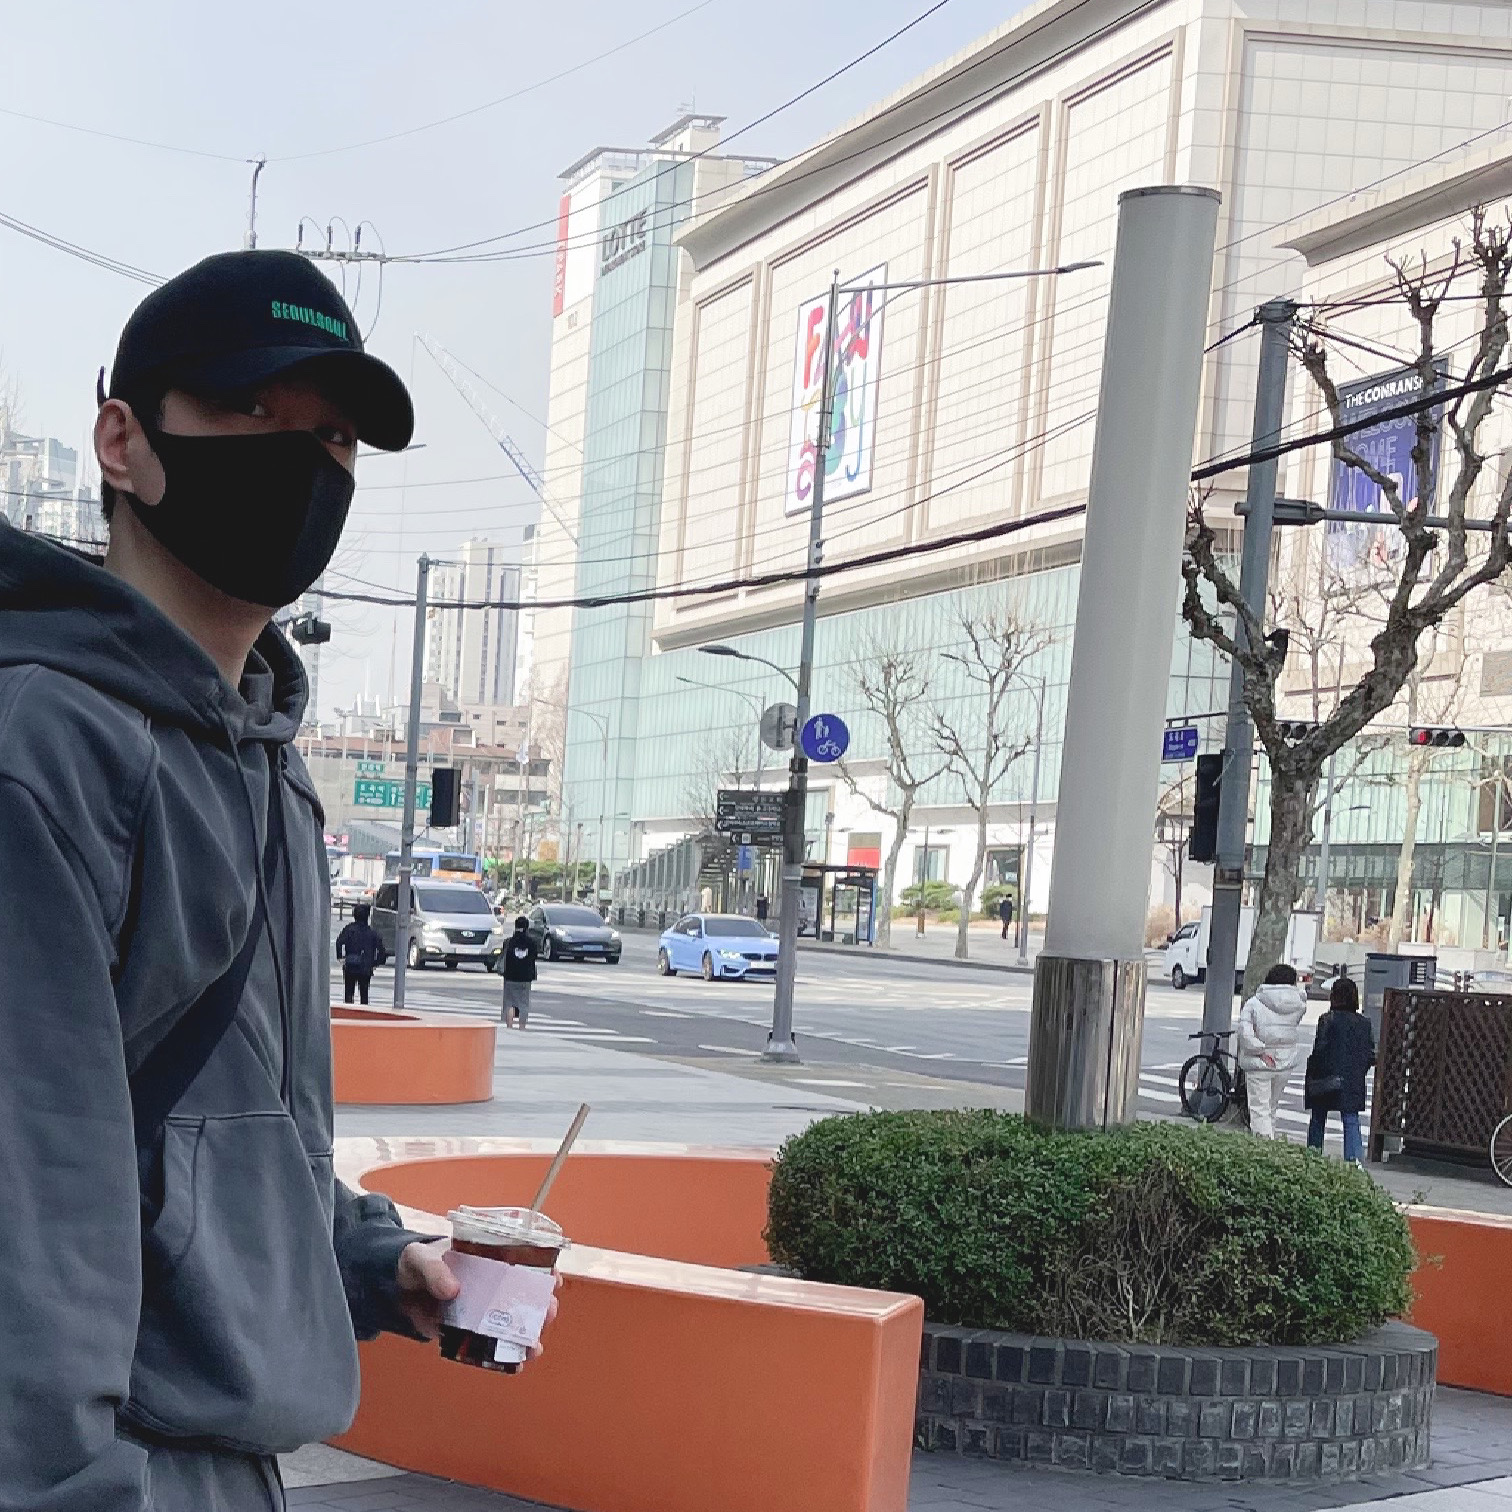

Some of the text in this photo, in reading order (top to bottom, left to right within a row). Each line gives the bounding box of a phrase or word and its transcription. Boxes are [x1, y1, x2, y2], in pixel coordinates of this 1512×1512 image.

[601, 207, 648, 263] LOTTE
[1345, 388, 1365, 409] THE
[1364, 379, 1412, 403] CONRAN
